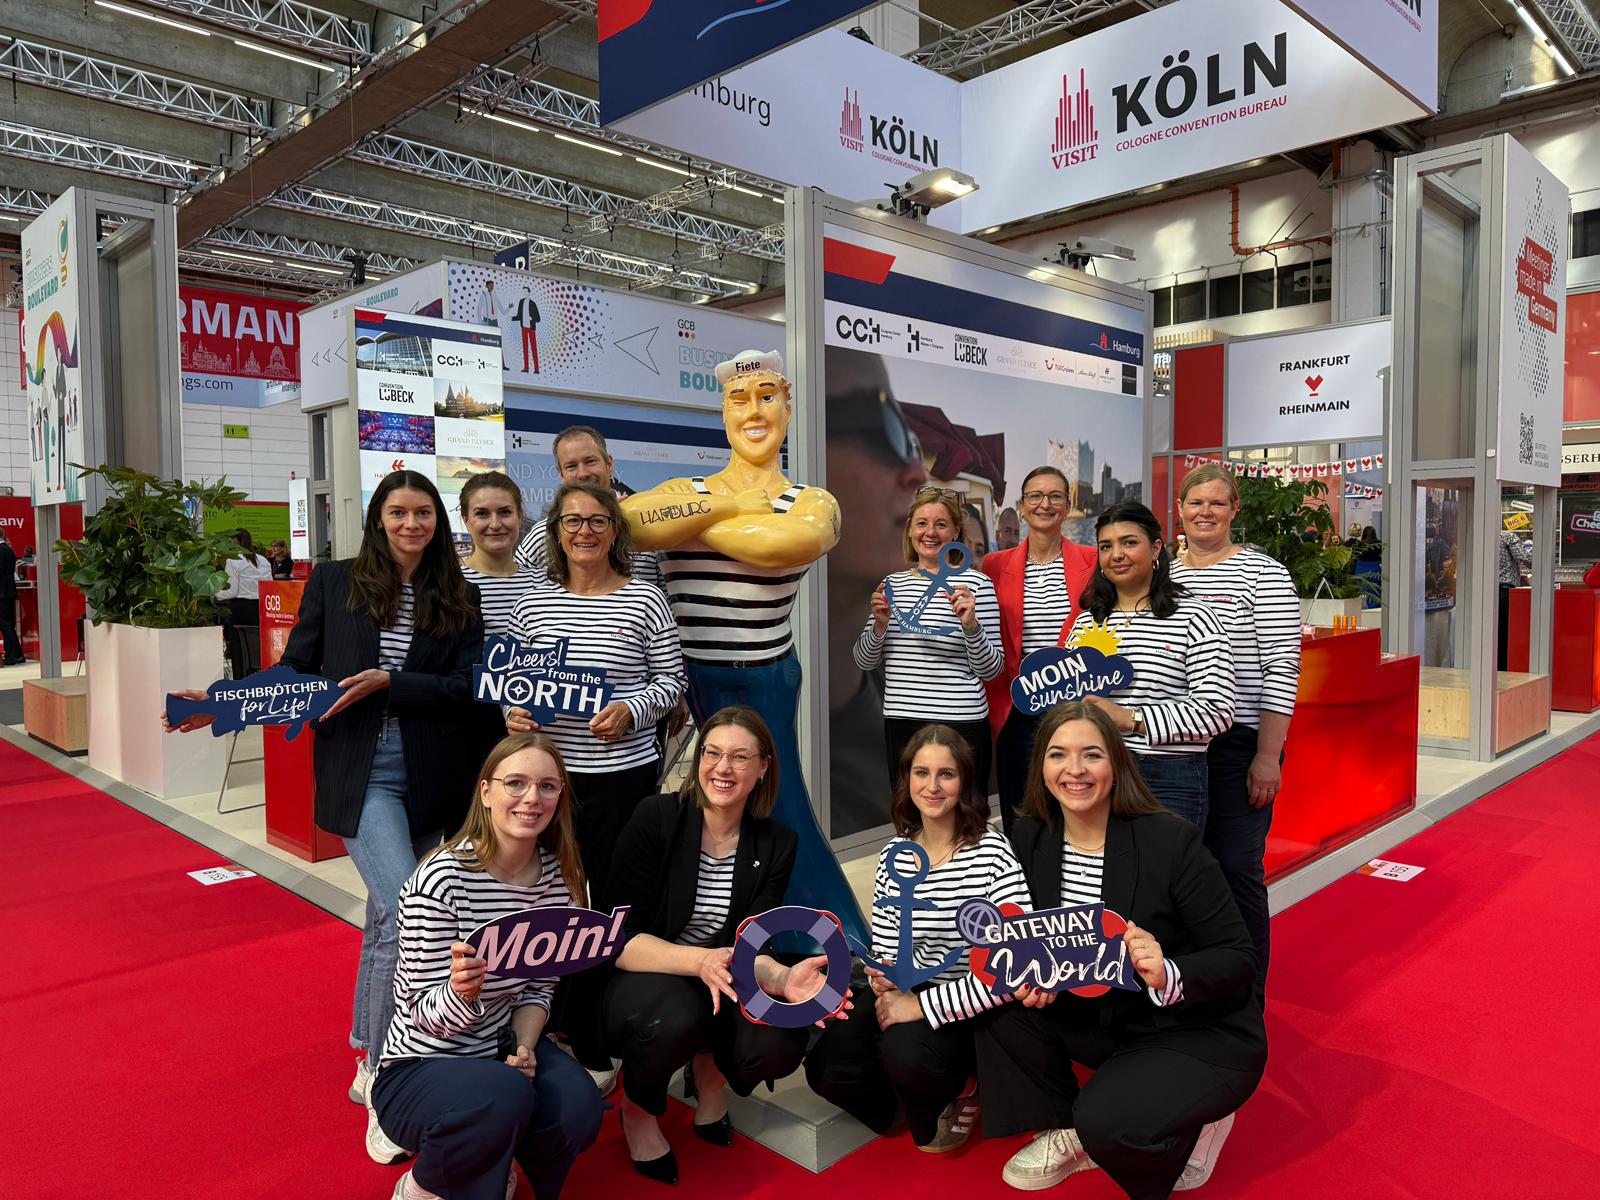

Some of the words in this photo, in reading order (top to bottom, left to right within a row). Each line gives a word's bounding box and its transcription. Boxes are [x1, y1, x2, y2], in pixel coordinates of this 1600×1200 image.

[1111, 32, 1288, 134] KÖLN
[1115, 130, 1163, 152] COLOGNE
[1165, 110, 1237, 141] CONVENTION
[1239, 95, 1287, 119] BUREAU
[840, 136, 864, 153] VISIT
[870, 115, 938, 168] KÖLN
[872, 151, 892, 164] COLOGNE
[1051, 144, 1100, 170] VISIT
[1525, 245, 1550, 280] Meetings
[27, 275, 59, 311] BOULEVARD
[1520, 269, 1536, 291] made
[1537, 274, 1543, 295] in
[366, 287, 399, 306] BOULEVARD
[677, 318, 696, 331] GCB
[1531, 295, 1556, 329] Germany
[836, 315, 881, 344] CCH
[955, 333, 978, 345] CONVENTION
[955, 342, 987, 366] LÜBECK
[1112, 339, 1141, 358] Hamburg
[735, 360, 761, 373] Fiete
[1279, 354, 1351, 372] FRANKFURT
[379, 388, 415, 403] LÜBECK
[1279, 400, 1350, 416] RHEINMAIN
[265, 594, 281, 611] GCB
[910, 595, 928, 621] AHOI
[901, 620, 932, 634] HAMBURG
[488, 641, 564, 672] Cheers!
[548, 667, 577, 682] from
[581, 673, 601, 684] the
[1018, 653, 1088, 696] MOIN
[215, 680, 328, 702] FISCHBRÖTCHEN
[478, 672, 604, 714] NORTH
[1029, 668, 1125, 712] sunshine
[240, 699, 269, 721] for
[267, 691, 313, 719] Life!
[984, 909, 1096, 944] GATEWAY
[475, 911, 626, 972] Moin!
[1047, 934, 1068, 949] TO
[1070, 933, 1099, 947] THE
[990, 940, 1127, 989] World
